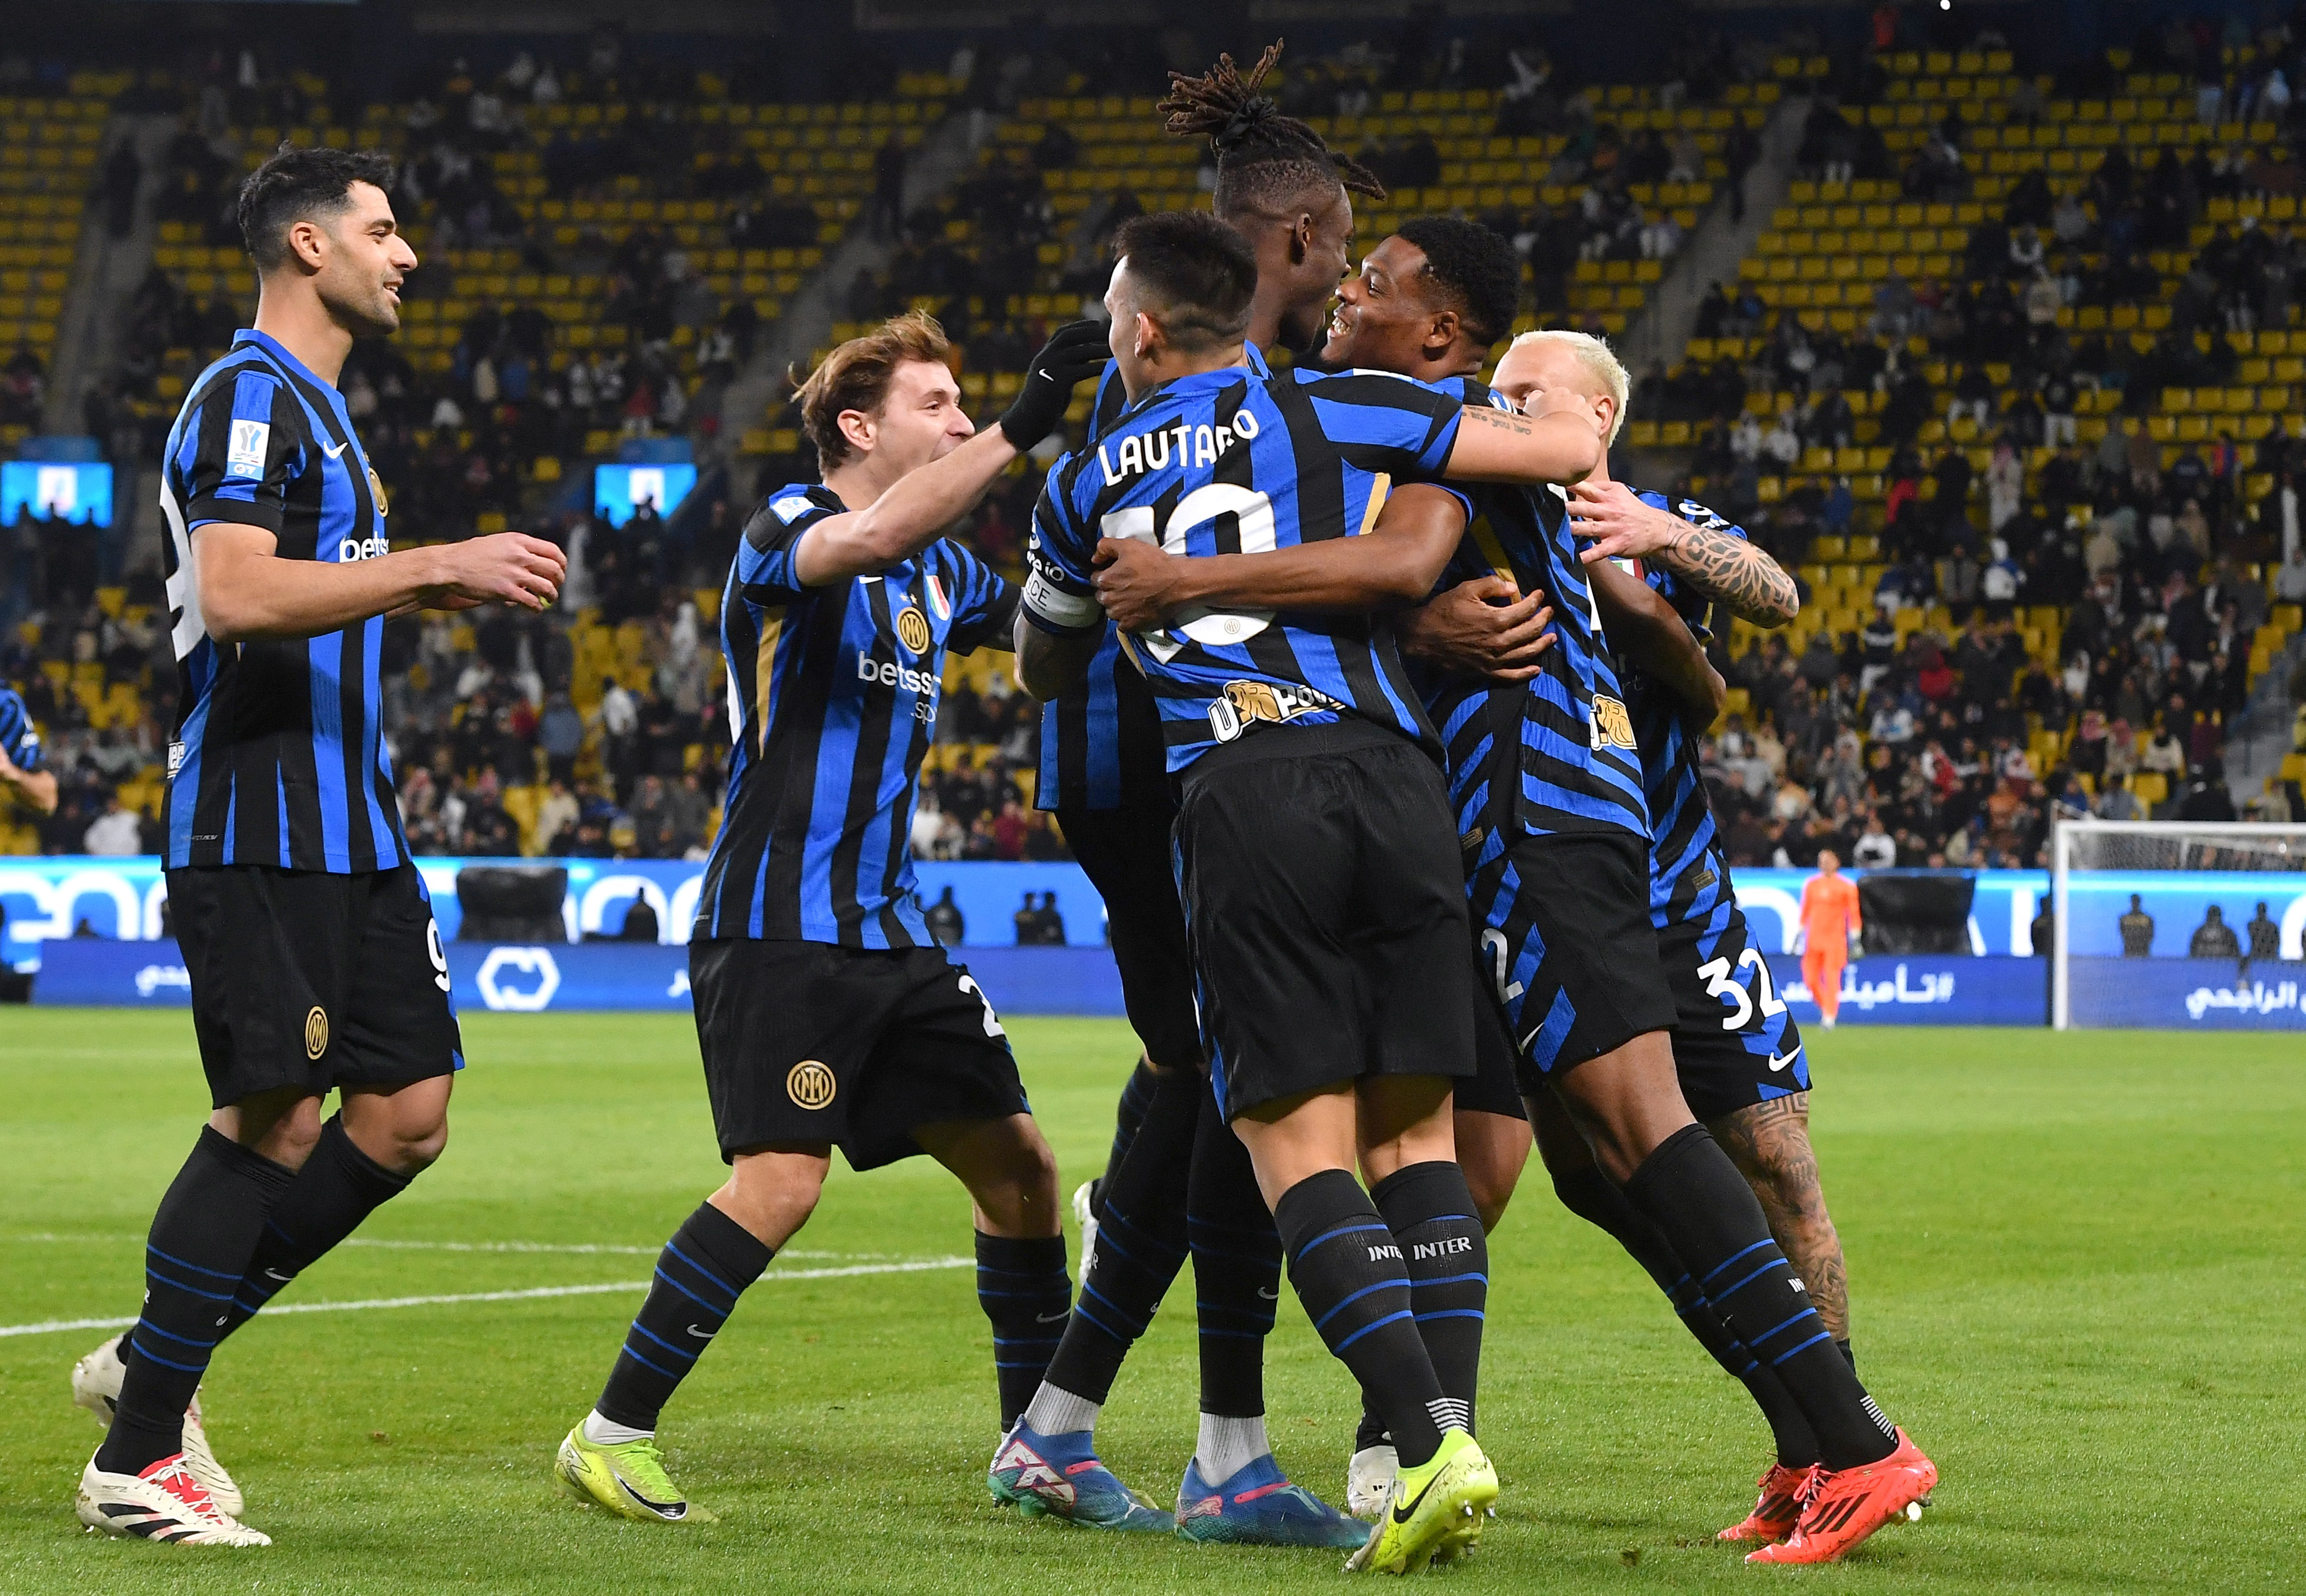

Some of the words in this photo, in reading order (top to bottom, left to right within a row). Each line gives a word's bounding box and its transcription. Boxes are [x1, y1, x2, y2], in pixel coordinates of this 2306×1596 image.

[427, 917, 451, 992] 9
[1697, 948, 1788, 1030] 32
[1413, 1236, 1473, 1261] INTER
